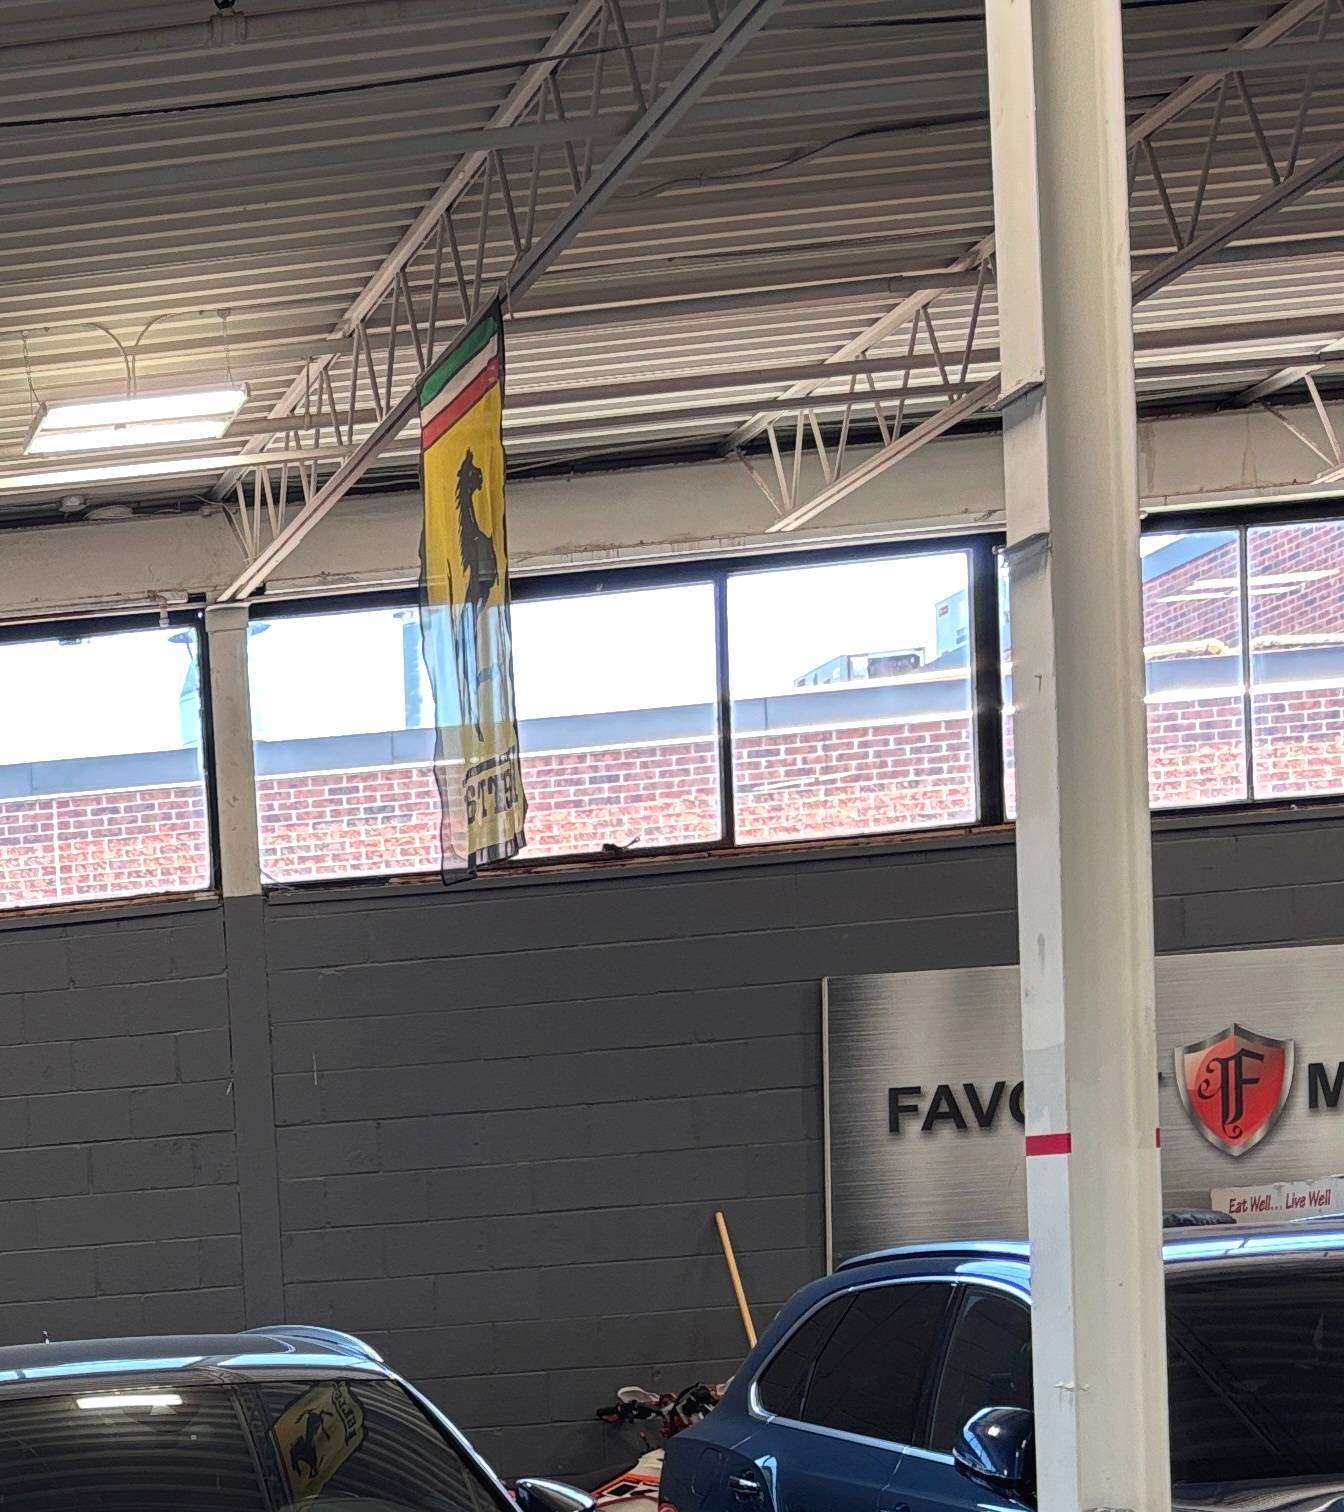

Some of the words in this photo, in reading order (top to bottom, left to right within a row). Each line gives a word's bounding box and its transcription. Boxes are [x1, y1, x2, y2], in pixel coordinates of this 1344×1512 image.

[1228, 1198, 1249, 1214] Eat
[1285, 1191, 1306, 1210] Live
[1308, 1188, 1332, 1208] Well
